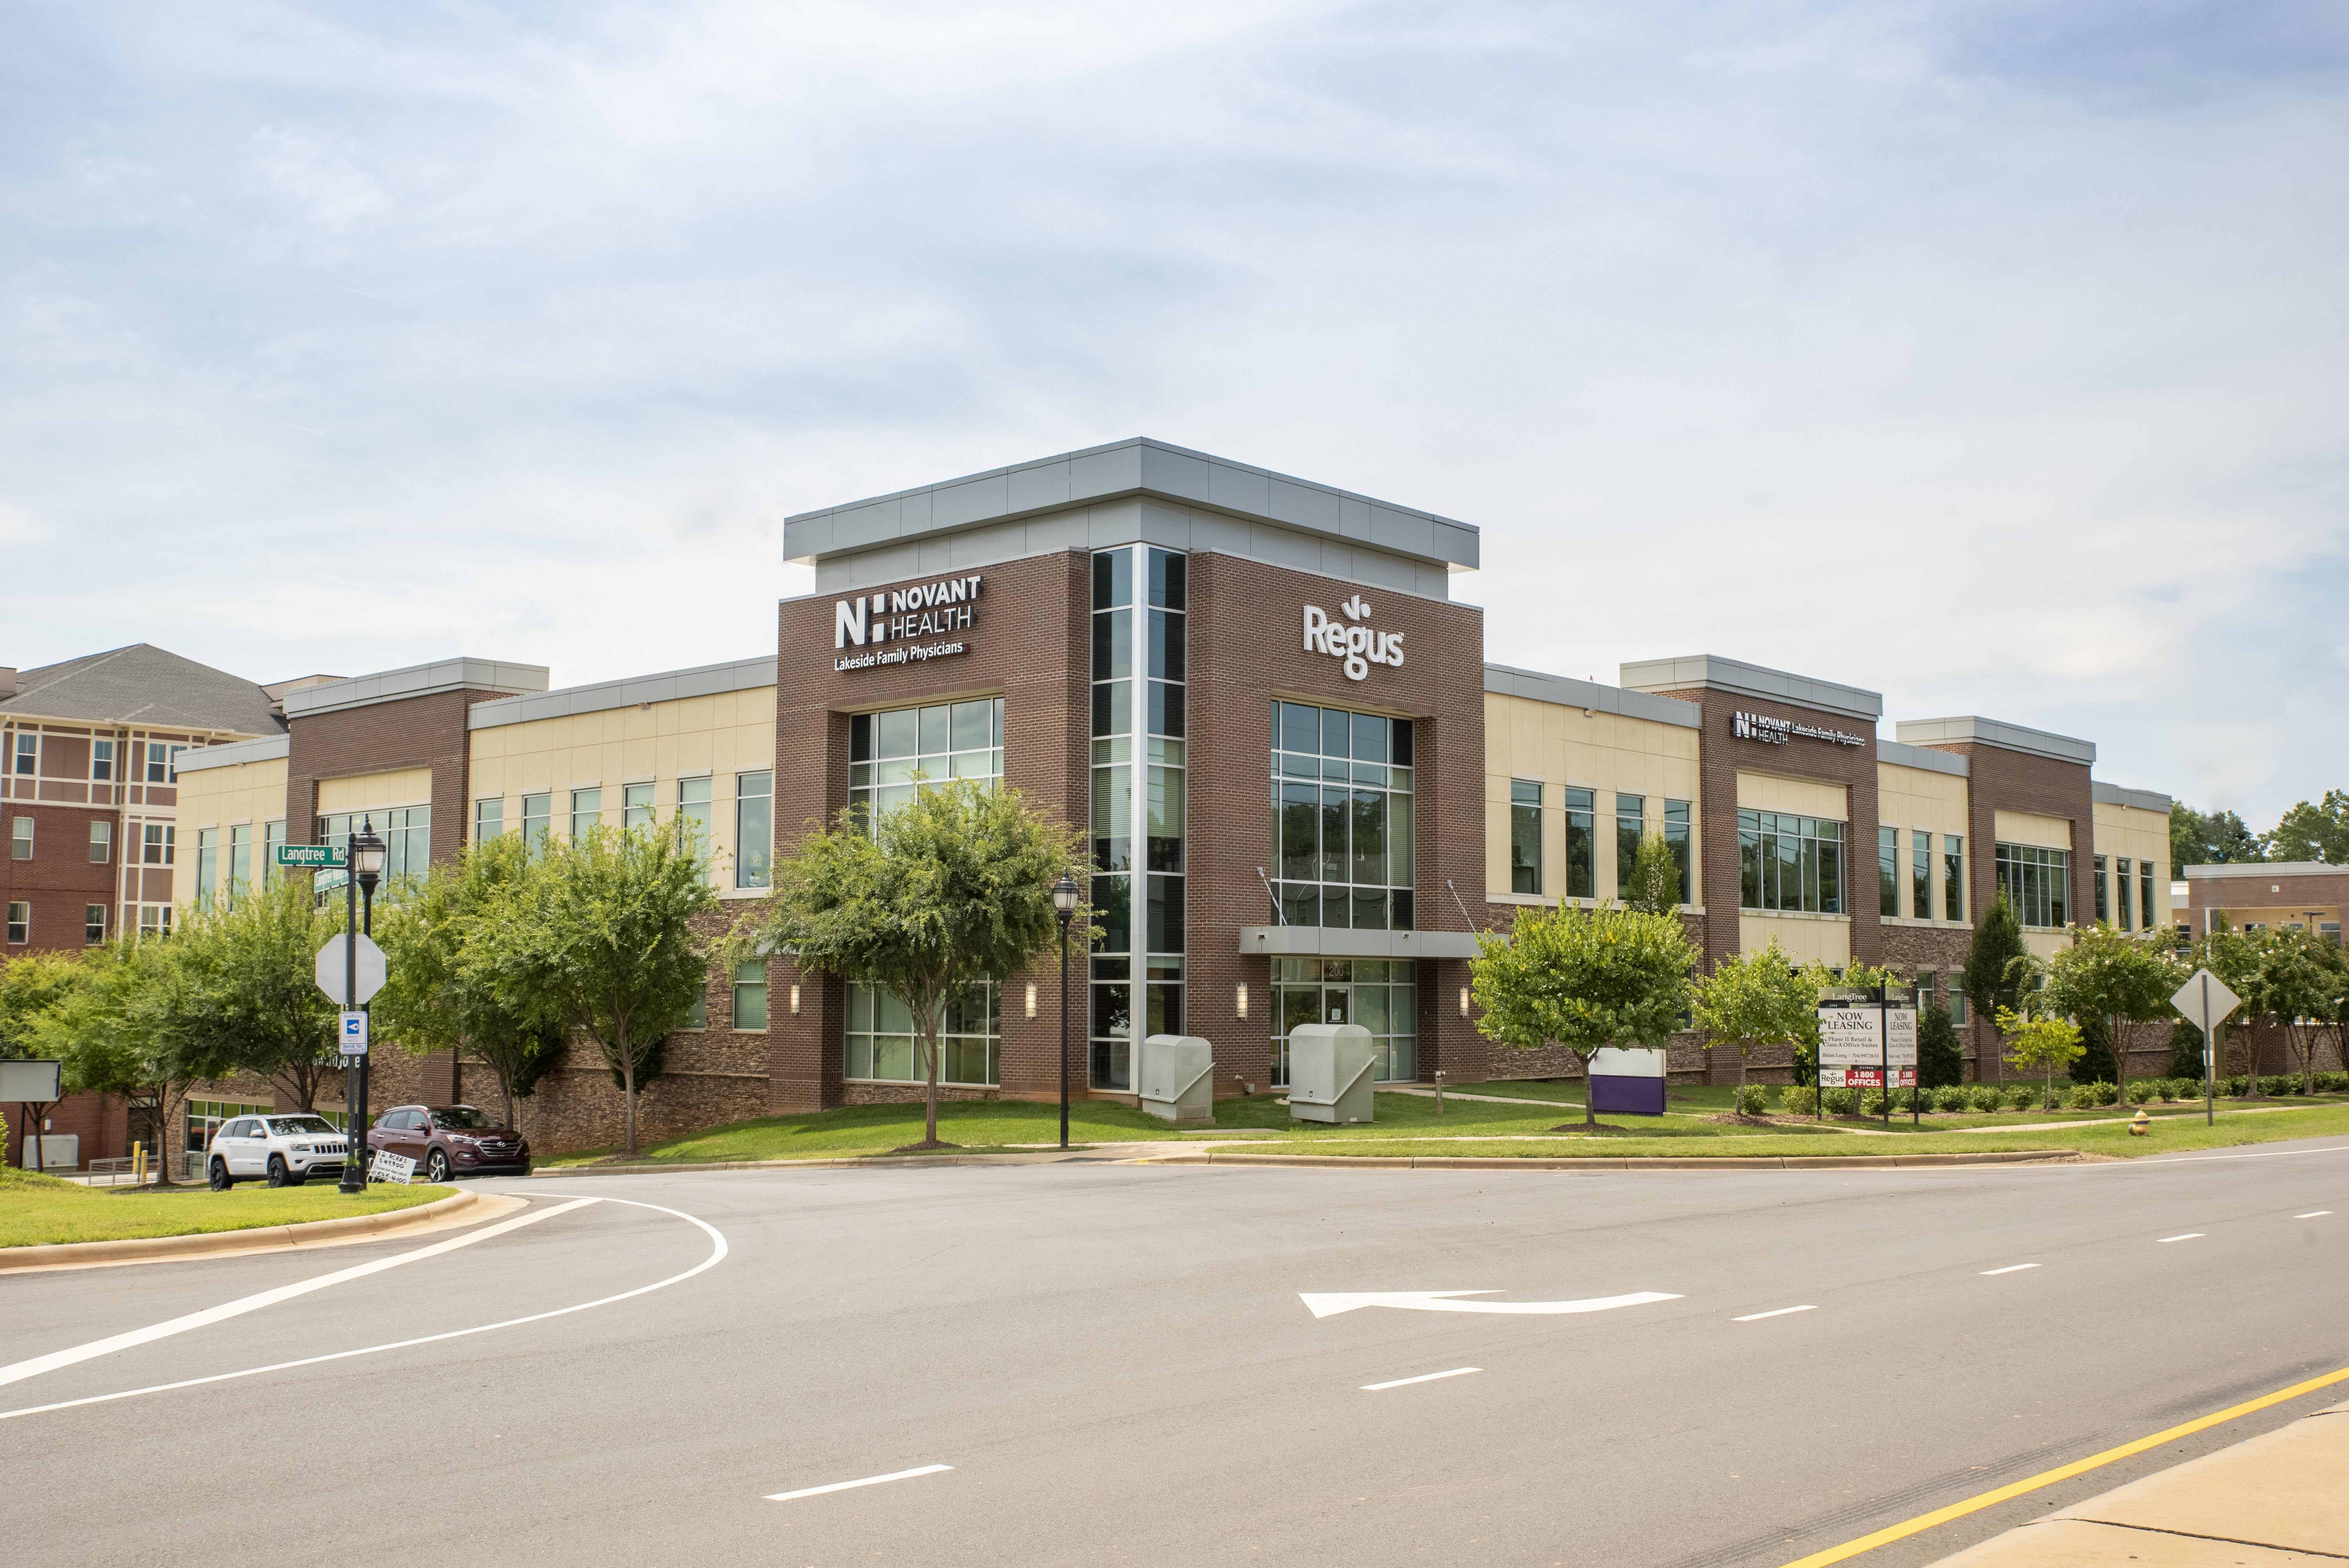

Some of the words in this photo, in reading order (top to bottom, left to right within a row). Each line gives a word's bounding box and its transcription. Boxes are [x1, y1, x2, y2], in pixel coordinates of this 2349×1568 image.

[892, 575, 982, 613] NOVANT
[892, 605, 972, 640] HEALTH
[1304, 605, 1404, 680] Regus
[835, 653, 874, 671] Lakeside
[877, 647, 908, 664] Family
[911, 641, 963, 661] Physicians
[1759, 716, 1790, 732] NOVANT
[1792, 722, 1817, 737] Lakeside
[1818, 727, 1836, 743] Family
[1837, 731, 1865, 747] Physicians
[1759, 729, 1788, 745] HEALTH
[282, 846, 325, 865] Langtree
[333, 847, 344, 861] Rd
[1329, 966, 1344, 976] 200
[1832, 993, 1867, 1002] LangTree
[1892, 994, 1910, 1002] LangTree
[1895, 1013, 1908, 1021] NOW
[1828, 1021, 1872, 1030] LEASING
[1821, 1075, 1844, 1084] Regus
[389, 1154, 407, 1163] ACRES
